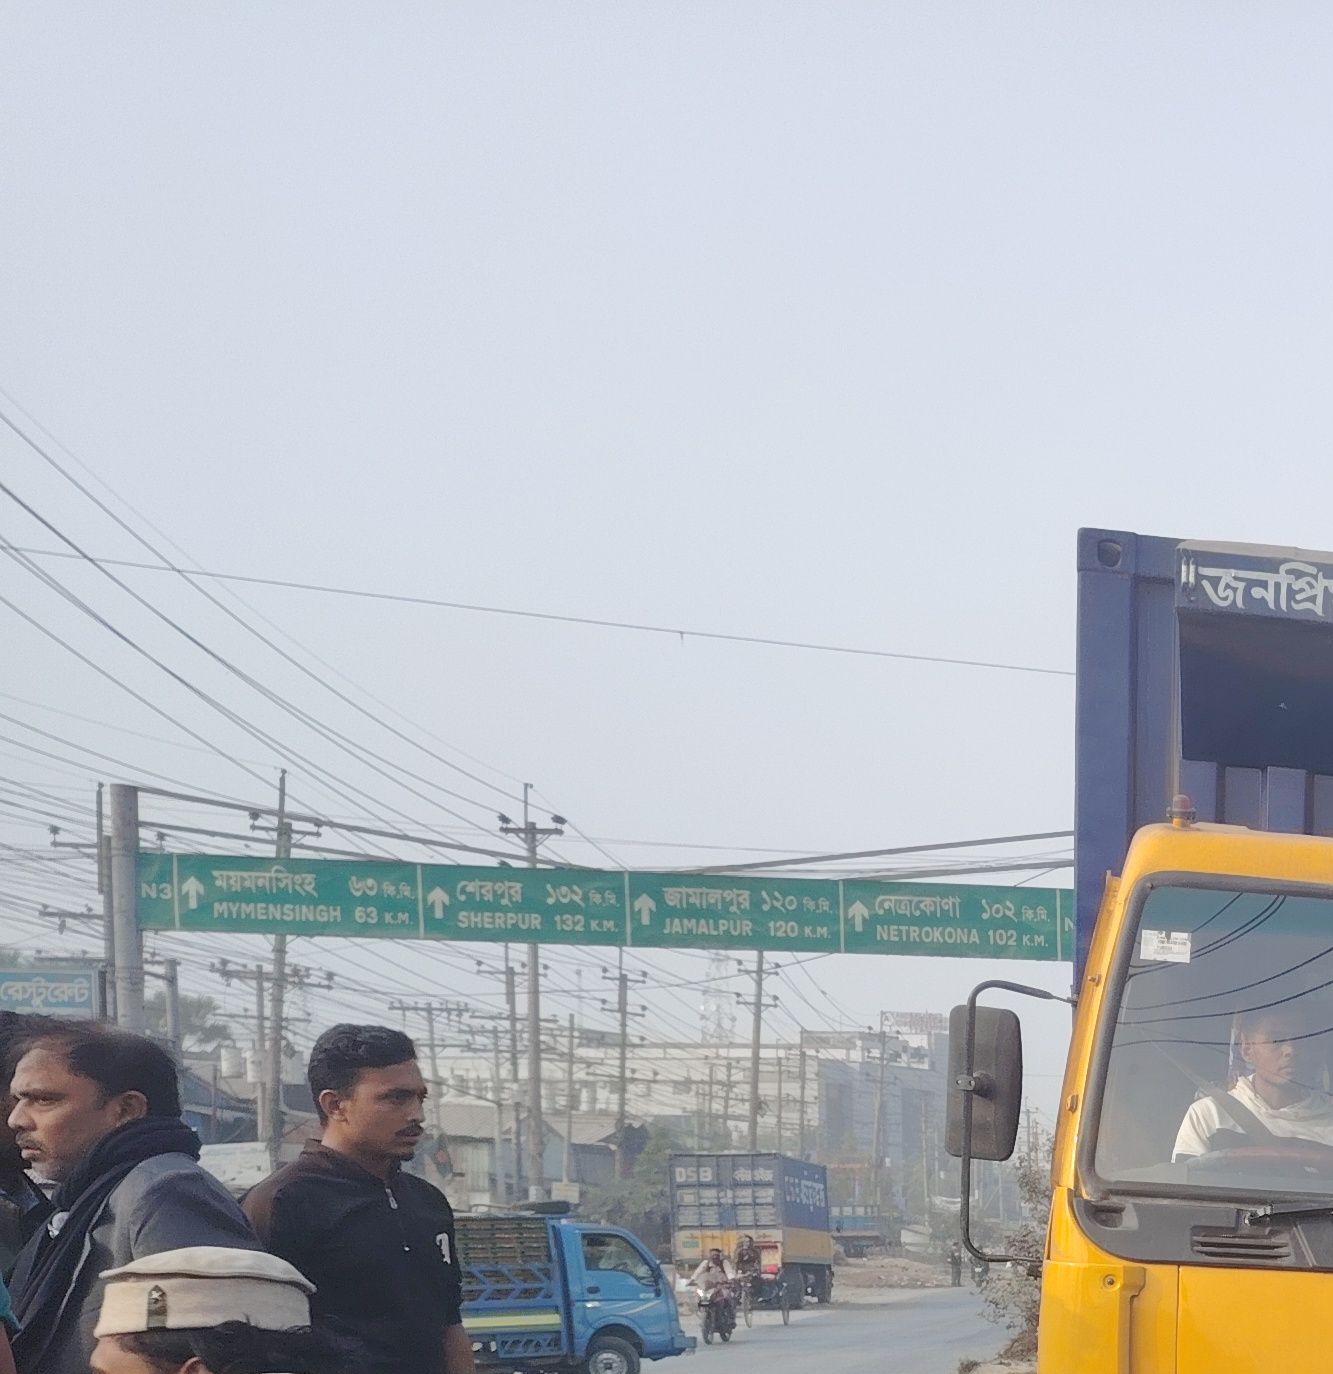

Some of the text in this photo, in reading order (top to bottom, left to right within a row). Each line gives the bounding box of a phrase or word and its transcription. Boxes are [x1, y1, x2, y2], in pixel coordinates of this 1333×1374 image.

[141, 883, 172, 899] N3
[212, 865, 318, 897] ময়মনসিংহ
[349, 875, 378, 897] ৬৩
[457, 879, 523, 907] শেরপুর
[546, 884, 585, 908] ১৩২
[662, 886, 750, 915] জামালপুর
[761, 890, 798, 913] ১২০
[213, 902, 414, 925] MYMENSINGH 63 K.M.
[875, 895, 961, 919] নেত্রকোণা
[981, 899, 1017, 922] ১০২
[457, 911, 618, 933] SHERPUR 132 K.M.
[663, 918, 831, 939] JAMALPUR 120 K.M.
[876, 925, 1049, 947] NETROKONA 102 K.M.
[675, 1167, 712, 1182] DSB
